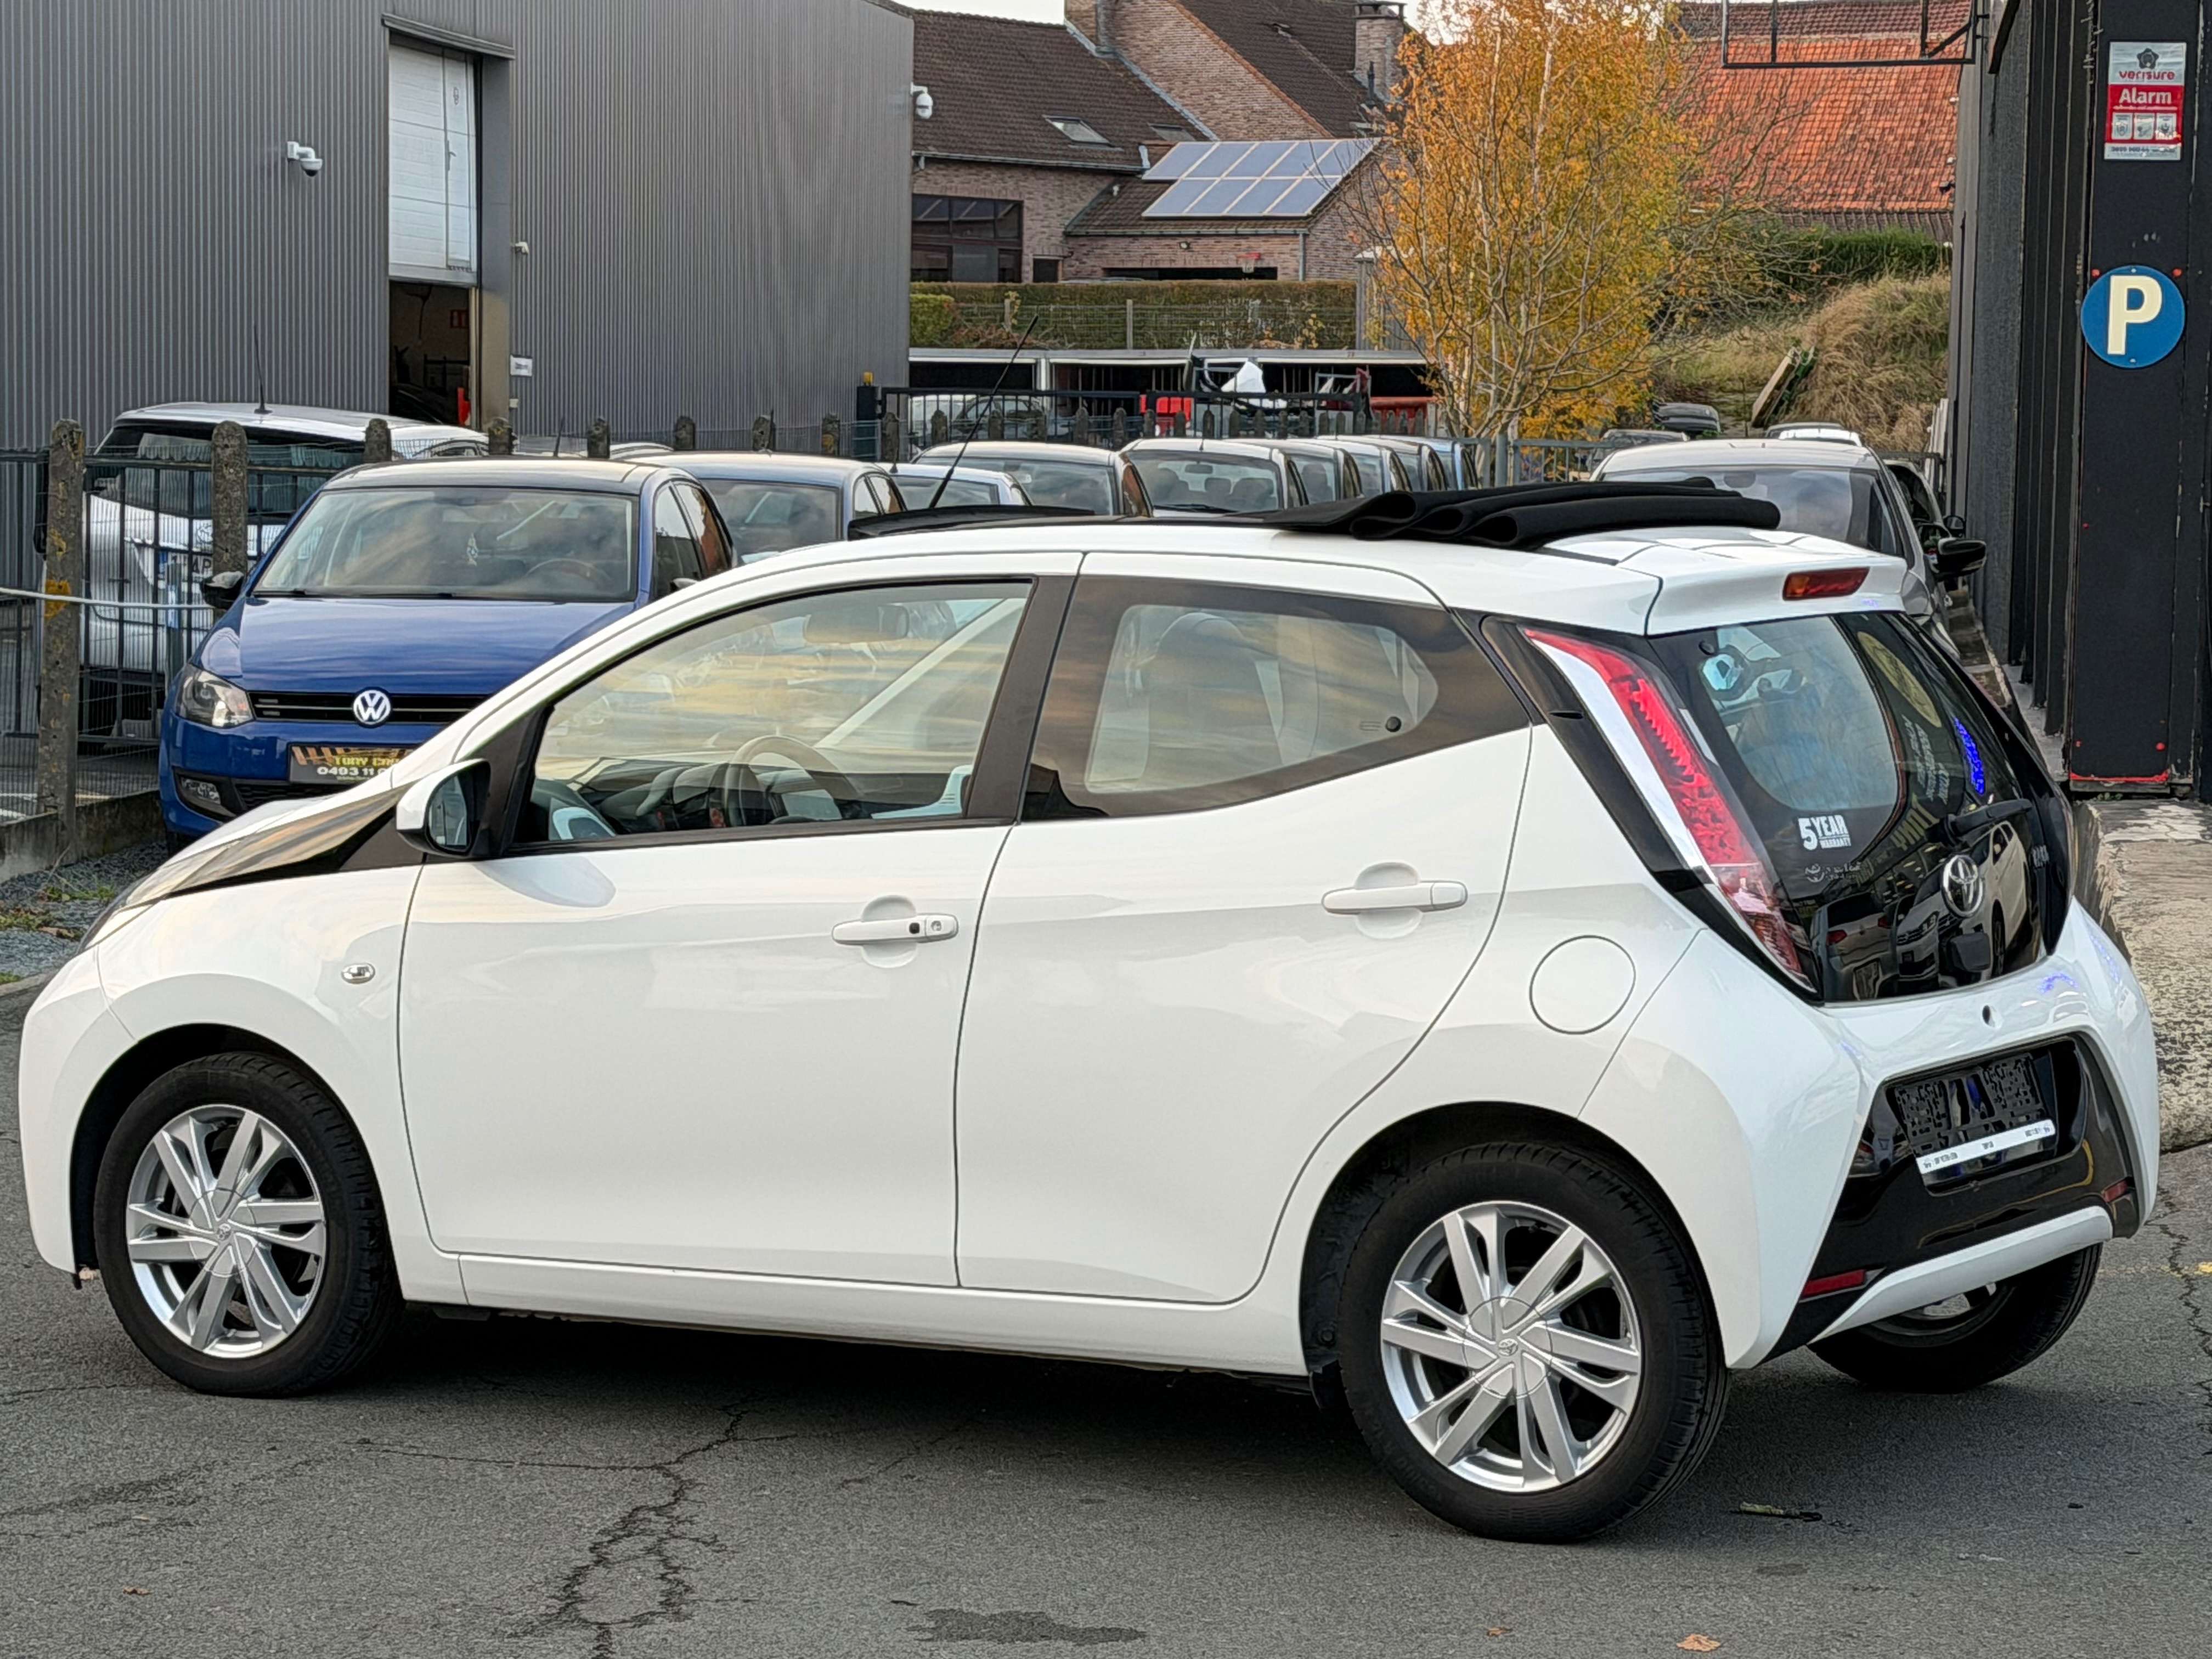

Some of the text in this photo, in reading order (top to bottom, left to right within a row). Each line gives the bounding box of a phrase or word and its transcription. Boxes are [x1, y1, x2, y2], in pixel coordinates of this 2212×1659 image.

[2119, 70, 2176, 81] verisure
[2119, 87, 2172, 105] Alarm
[2107, 275, 2163, 355] P
[1798, 815, 1849, 850] 5 YEAR
